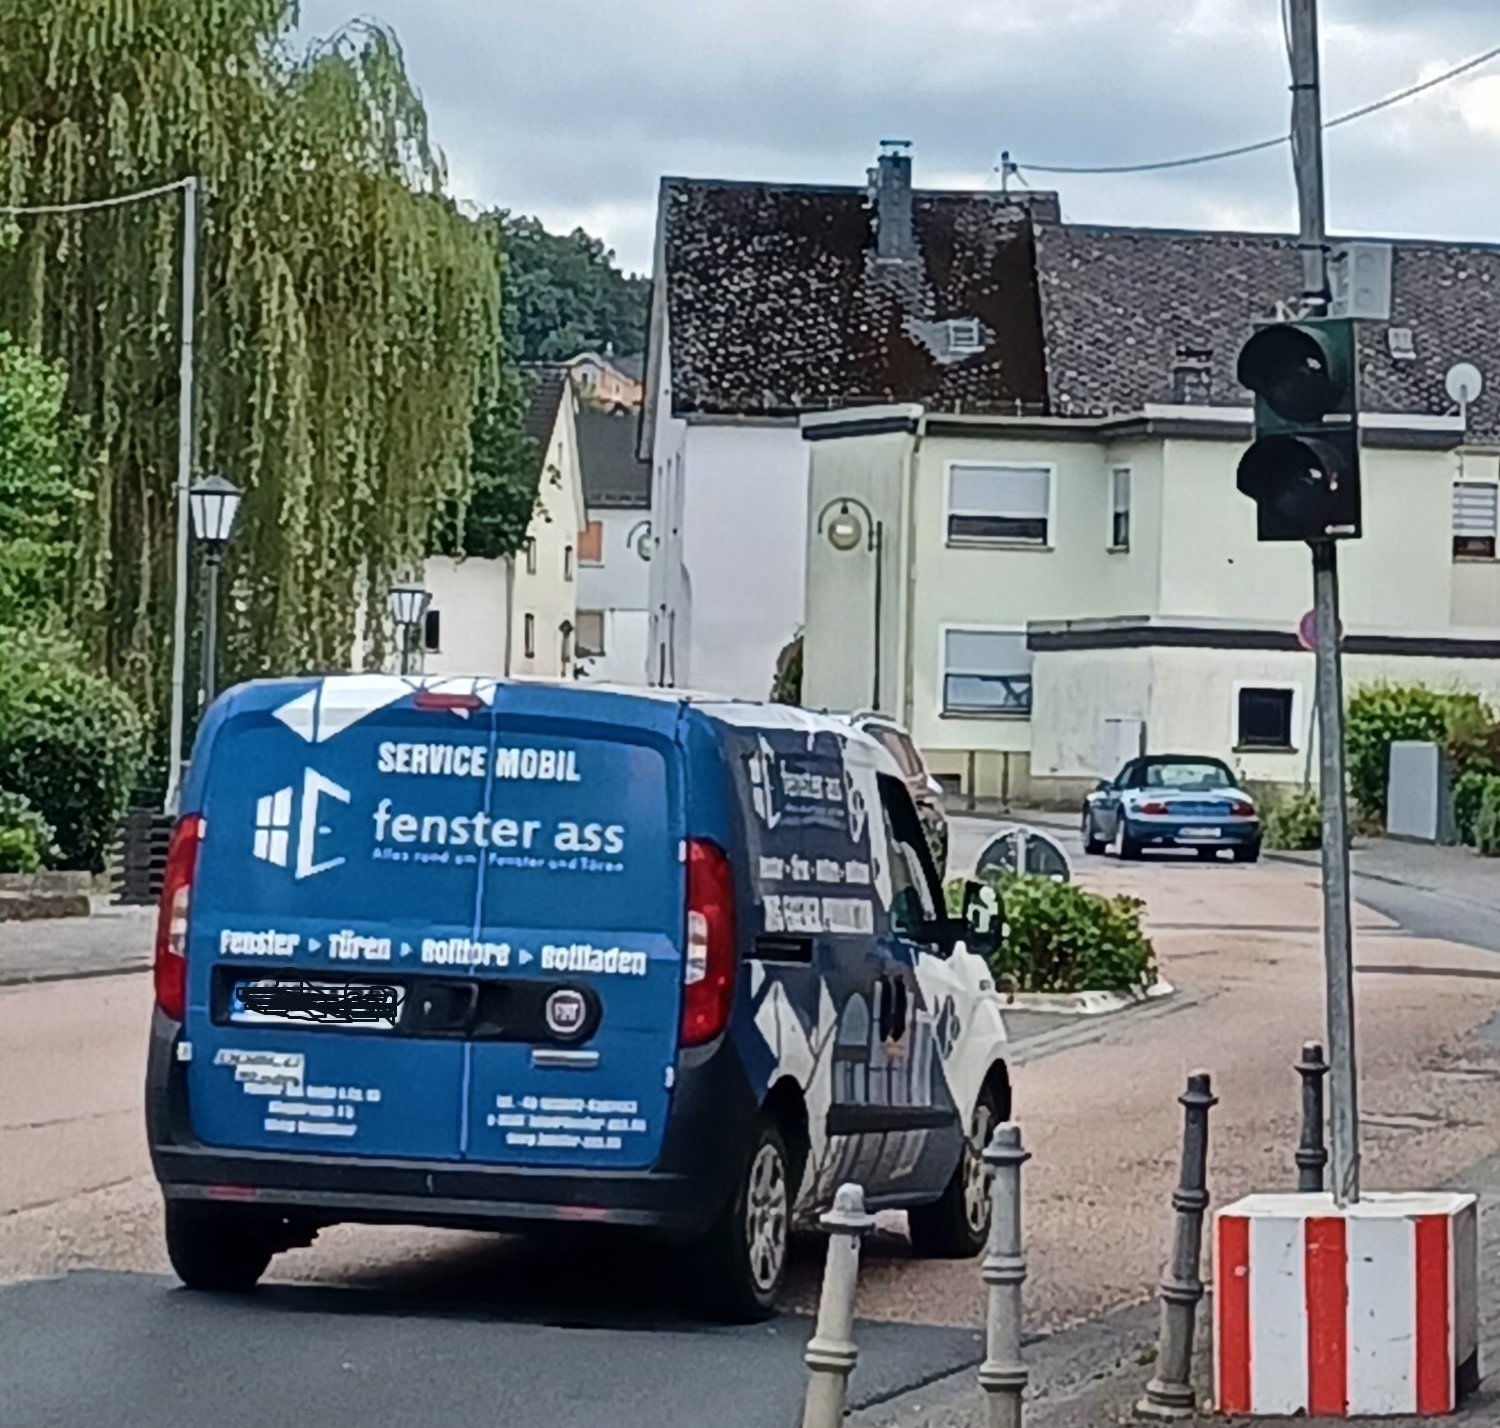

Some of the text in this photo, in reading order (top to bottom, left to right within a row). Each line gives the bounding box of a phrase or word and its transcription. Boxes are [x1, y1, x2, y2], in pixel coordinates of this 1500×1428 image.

[378, 741, 581, 782] SERVICE MOBIL
[372, 797, 625, 854] fenster ass
[220, 929, 300, 957] Fenster
[328, 929, 391, 960] Türen
